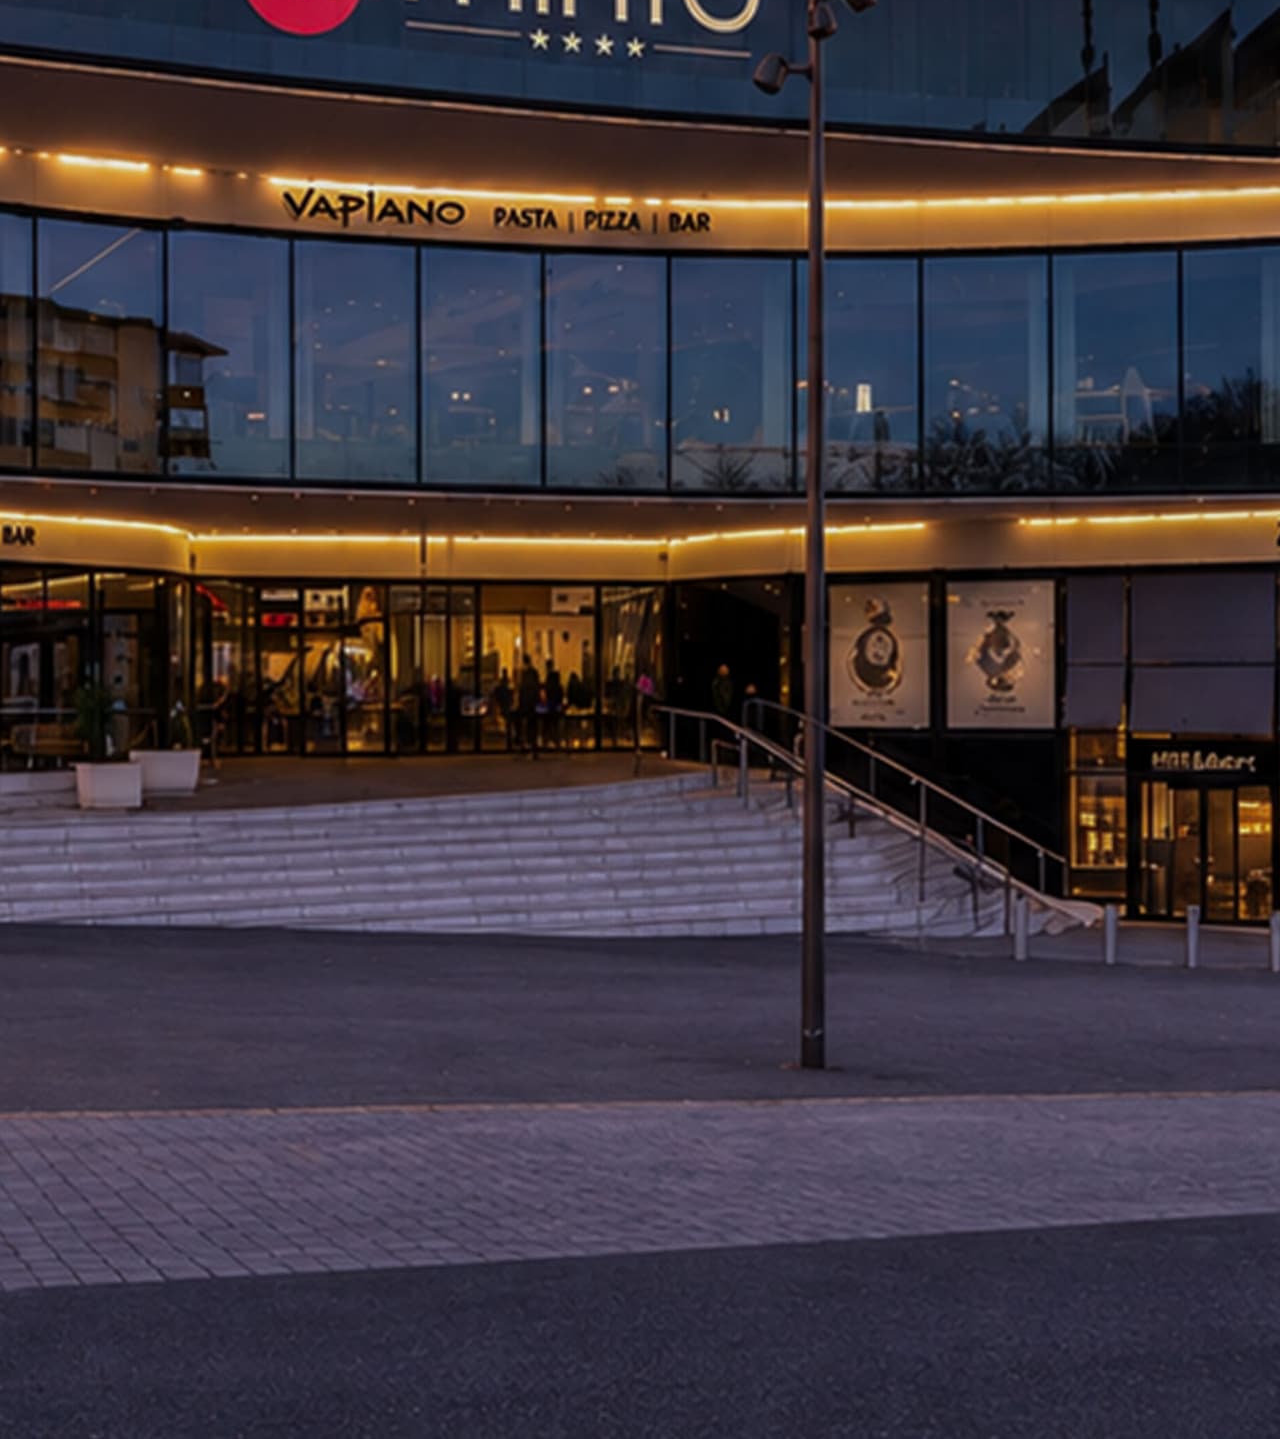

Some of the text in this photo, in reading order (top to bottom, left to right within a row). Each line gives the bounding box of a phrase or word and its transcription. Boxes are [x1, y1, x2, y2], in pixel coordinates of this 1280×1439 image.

[283, 190, 467, 228] VAPIANO
[493, 206, 558, 230] PASTA
[583, 210, 642, 232] PIZZA
[669, 211, 711, 233] BAR
[1, 523, 37, 548] BAR
